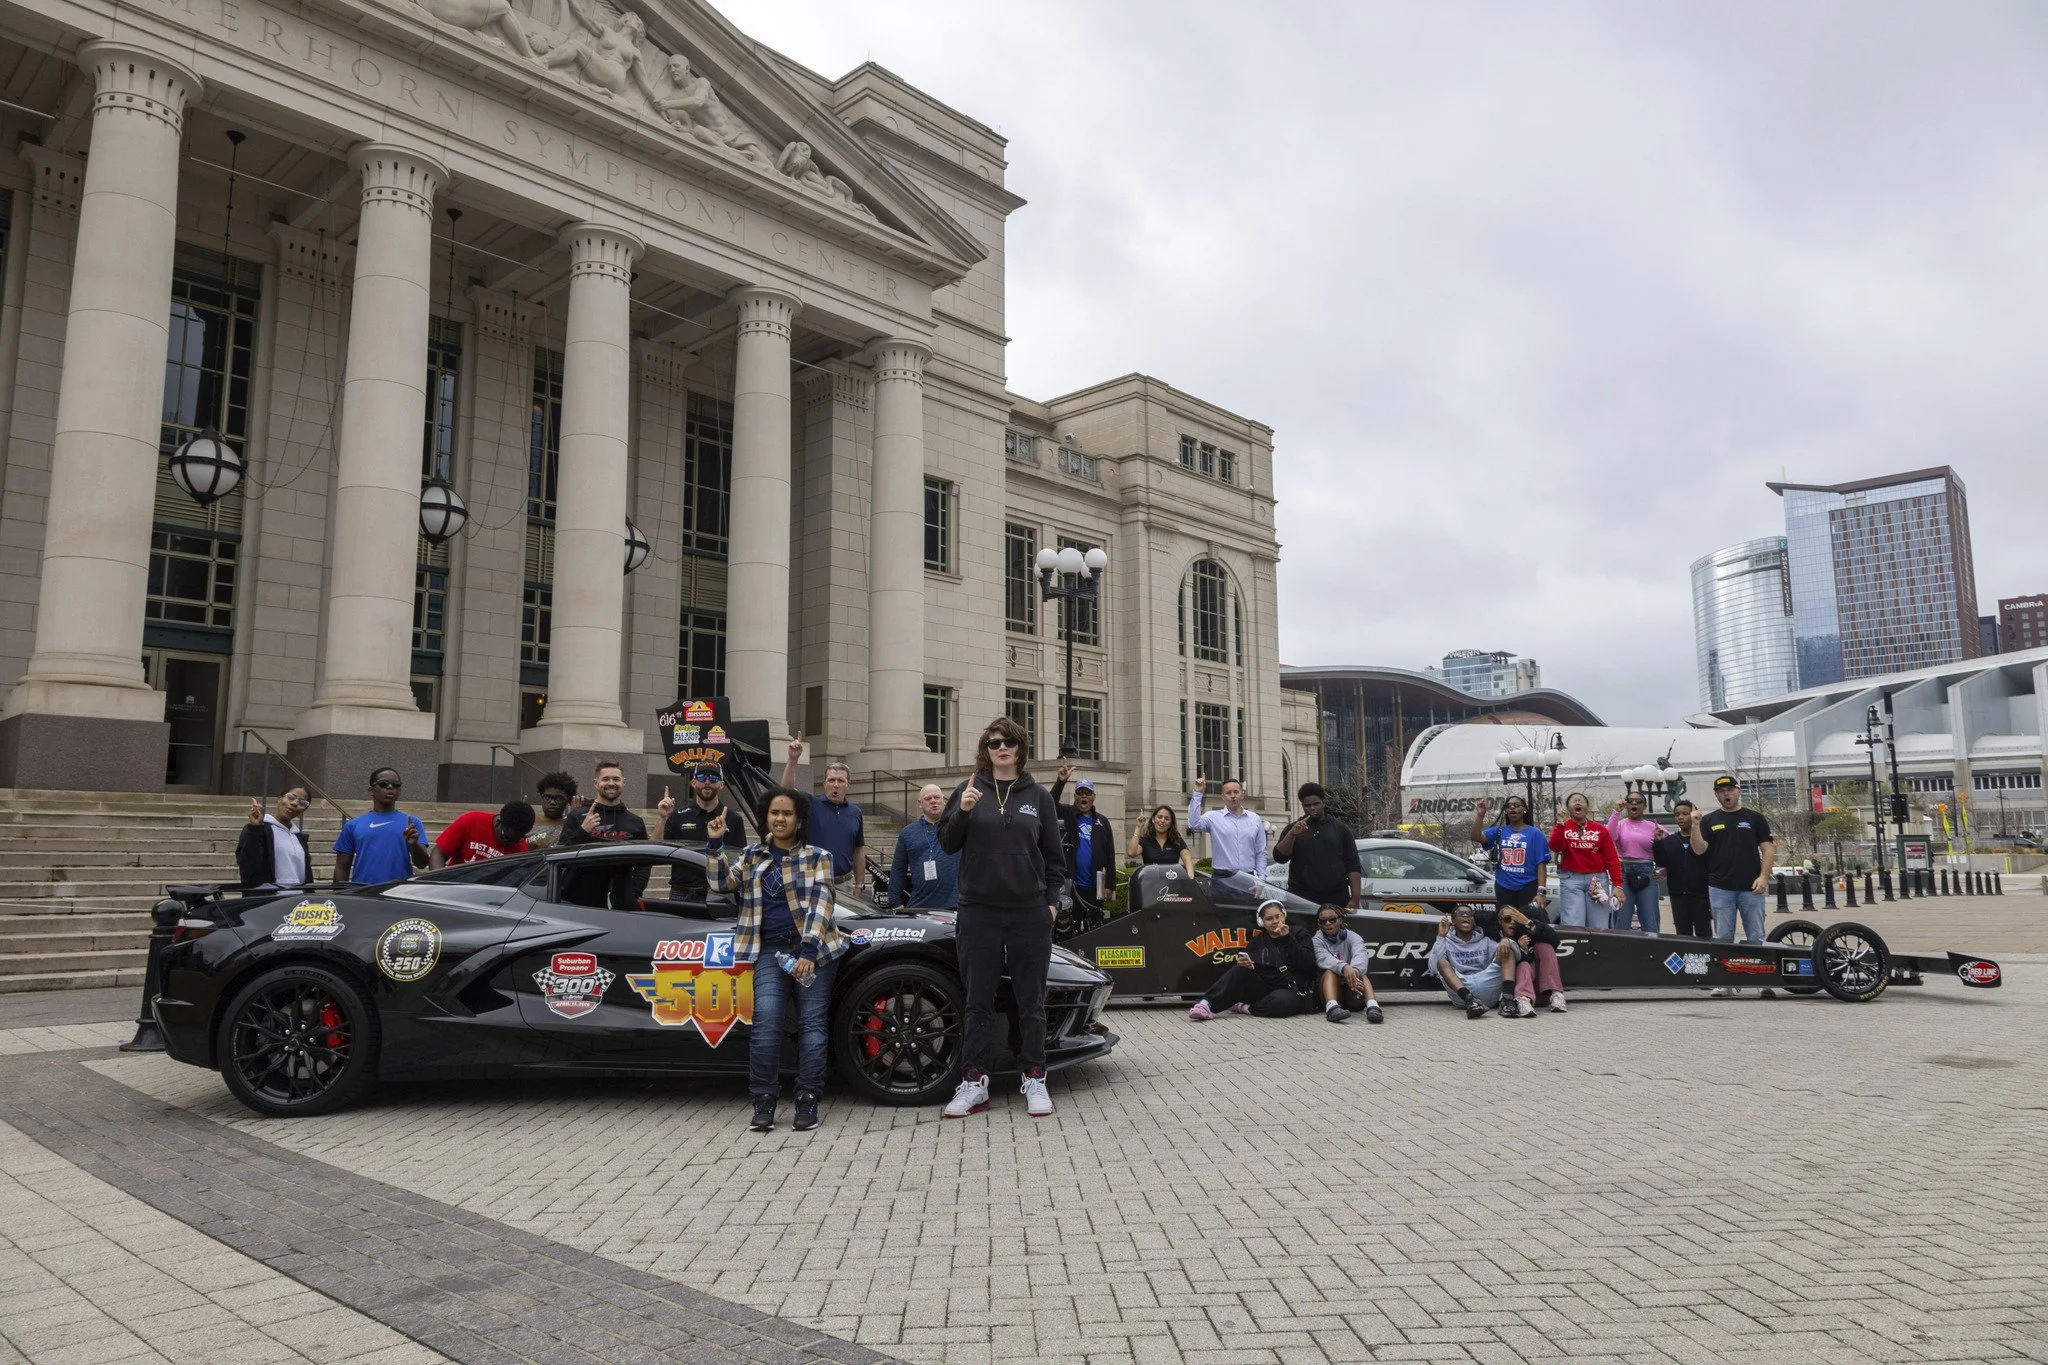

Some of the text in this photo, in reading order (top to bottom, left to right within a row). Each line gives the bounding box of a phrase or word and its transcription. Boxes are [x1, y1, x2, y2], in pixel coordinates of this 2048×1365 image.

[503, 119, 743, 235] SYMPHONY
[771, 232, 900, 301] CENTER
[669, 748, 725, 765] VALLEY
[470, 841, 488, 852] EAST
[1501, 839, 1527, 849] LET'S
[1411, 886, 1482, 894] NASHVILLE
[294, 910, 331, 920] BUSH'S
[396, 920, 418, 928] READY
[278, 925, 339, 934] QUALIFYING
[873, 928, 926, 938] Bristol
[654, 940, 706, 960] FOOD
[1100, 949, 1141, 959] PLEASANTON
[394, 957, 421, 970] 250
[559, 964, 589, 972] Propane
[395, 972, 413, 980] MOTOR
[552, 978, 595, 994] 300
